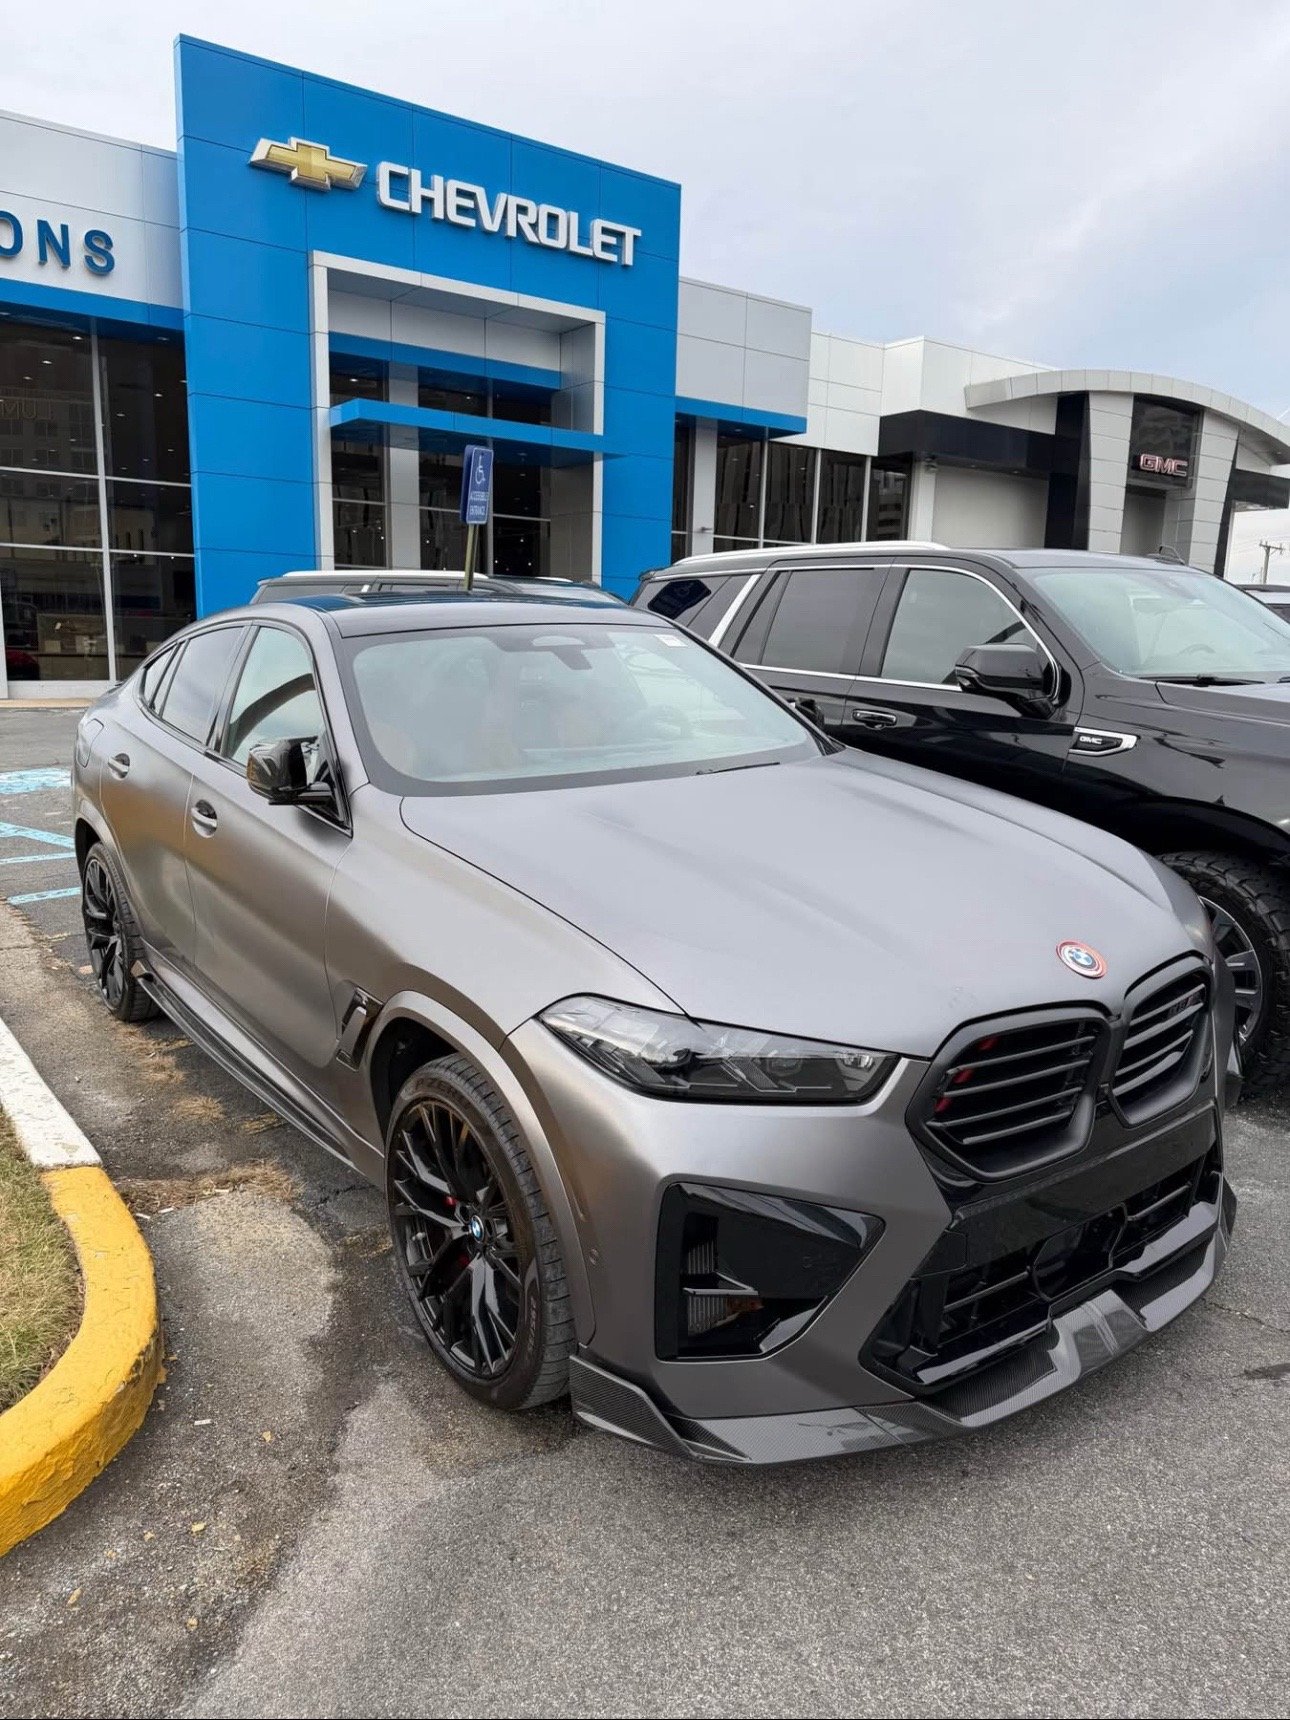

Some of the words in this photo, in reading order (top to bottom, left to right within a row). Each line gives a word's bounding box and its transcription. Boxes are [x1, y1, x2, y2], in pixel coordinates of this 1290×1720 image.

[377, 161, 642, 266] CHEVROLET
[1140, 454, 1188, 477] GMC
[1079, 735, 1103, 745] GMC
